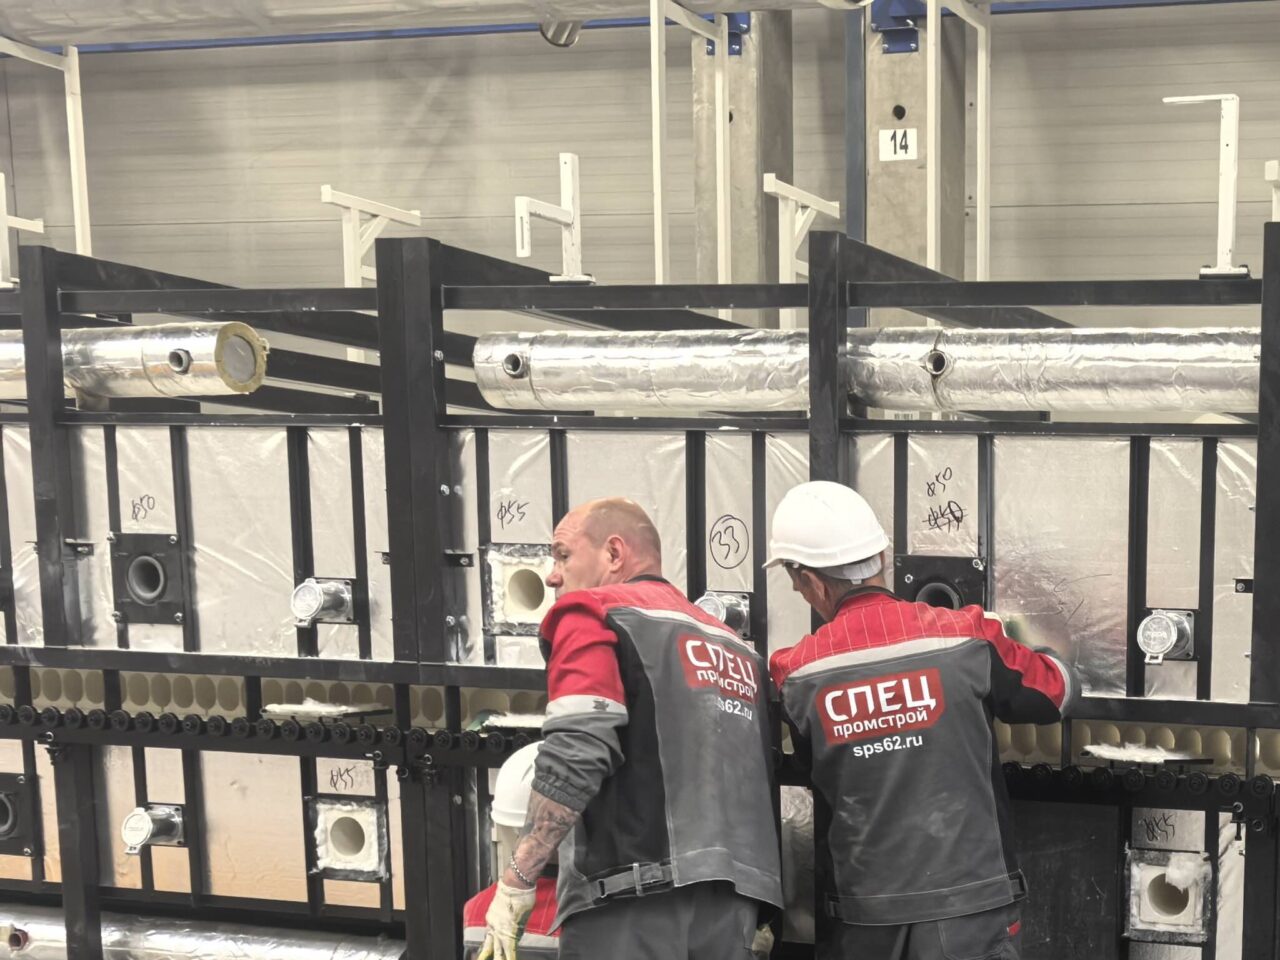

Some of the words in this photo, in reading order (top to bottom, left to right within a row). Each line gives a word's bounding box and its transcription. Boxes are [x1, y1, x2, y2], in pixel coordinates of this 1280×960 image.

[890, 129, 909, 155] 14
[685, 639, 758, 693] СПЕЦ
[824, 675, 937, 722] СПЕЦ
[832, 707, 929, 739] промстрой
[852, 735, 924, 759] sps62.ru
